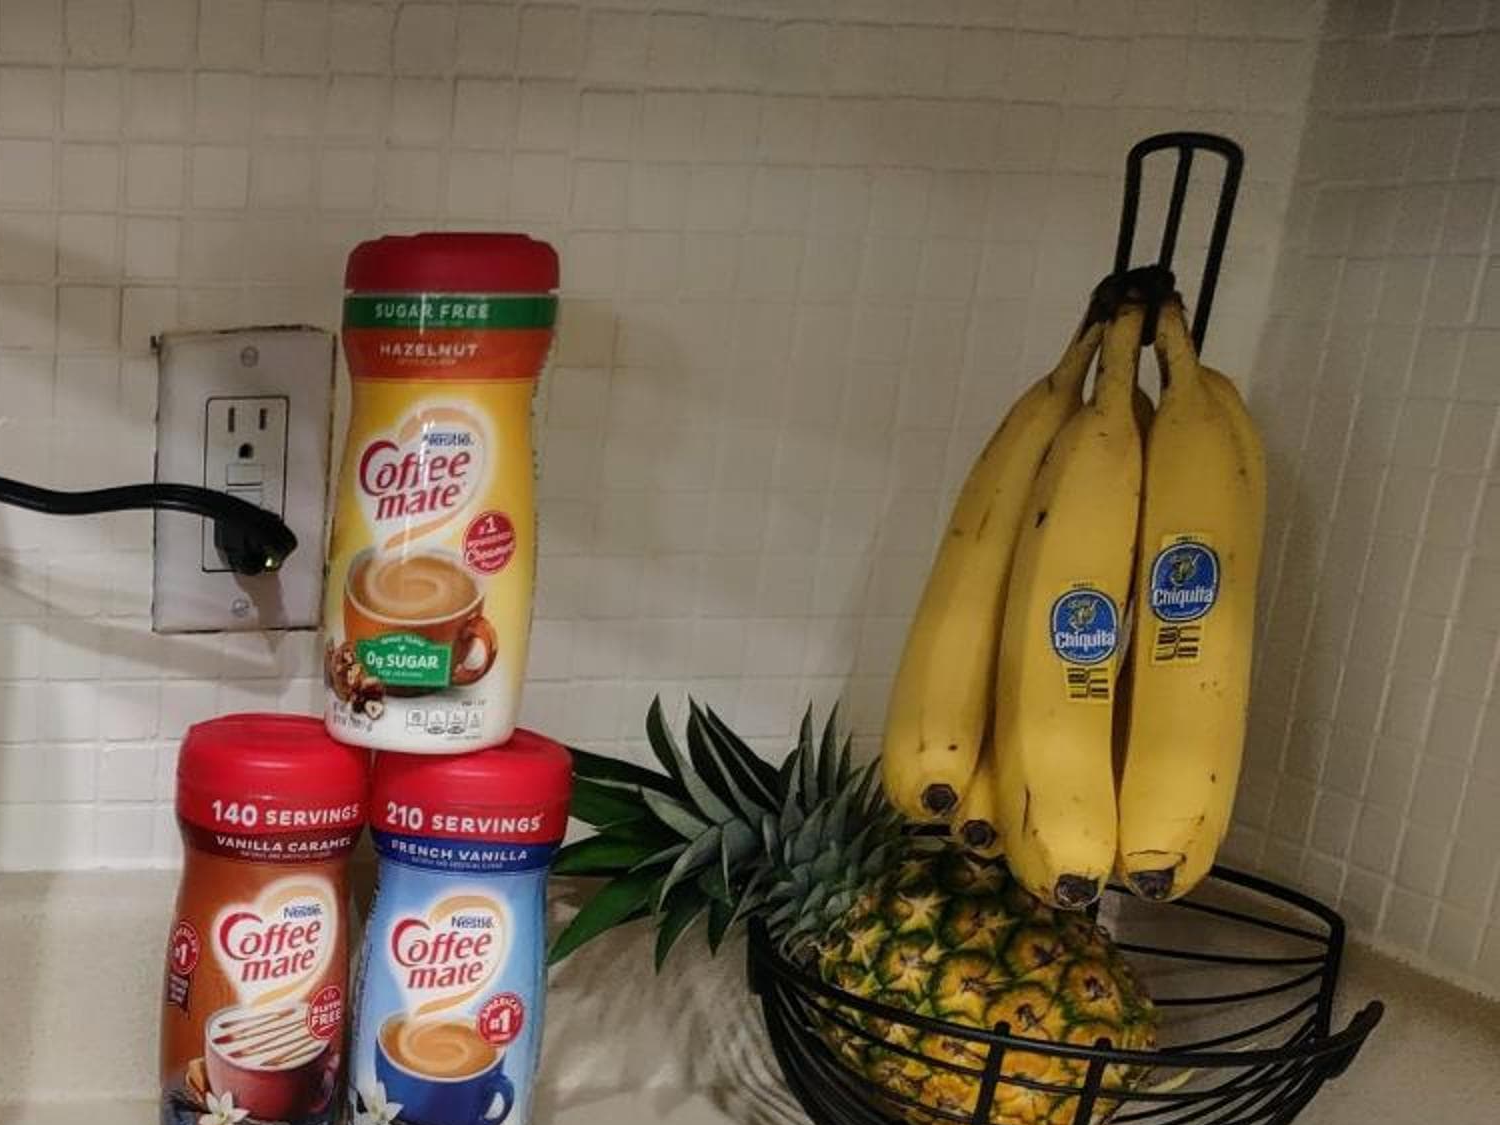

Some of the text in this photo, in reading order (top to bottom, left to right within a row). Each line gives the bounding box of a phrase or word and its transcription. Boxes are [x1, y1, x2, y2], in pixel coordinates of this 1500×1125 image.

[375, 304, 489, 318] SUGAR FREE
[380, 343, 478, 356] HAZELNUT
[359, 440, 471, 496] Coffee
[375, 483, 461, 520] mate
[1153, 587, 1213, 607] Chiquita
[1055, 630, 1116, 651] Chiquita
[366, 651, 439, 669] 0g SUGAR
[212, 800, 359, 827] 140 SERVINGS
[386, 801, 541, 834] 210 SERVINGS
[216, 835, 283, 852] VANILLA
[391, 840, 527, 862] FRENCH VANILLA
[219, 912, 321, 960] Coffee
[392, 918, 492, 967] Coffee
[242, 949, 315, 982] mate
[408, 961, 483, 989] mate
[311, 1008, 341, 1026] FREE
